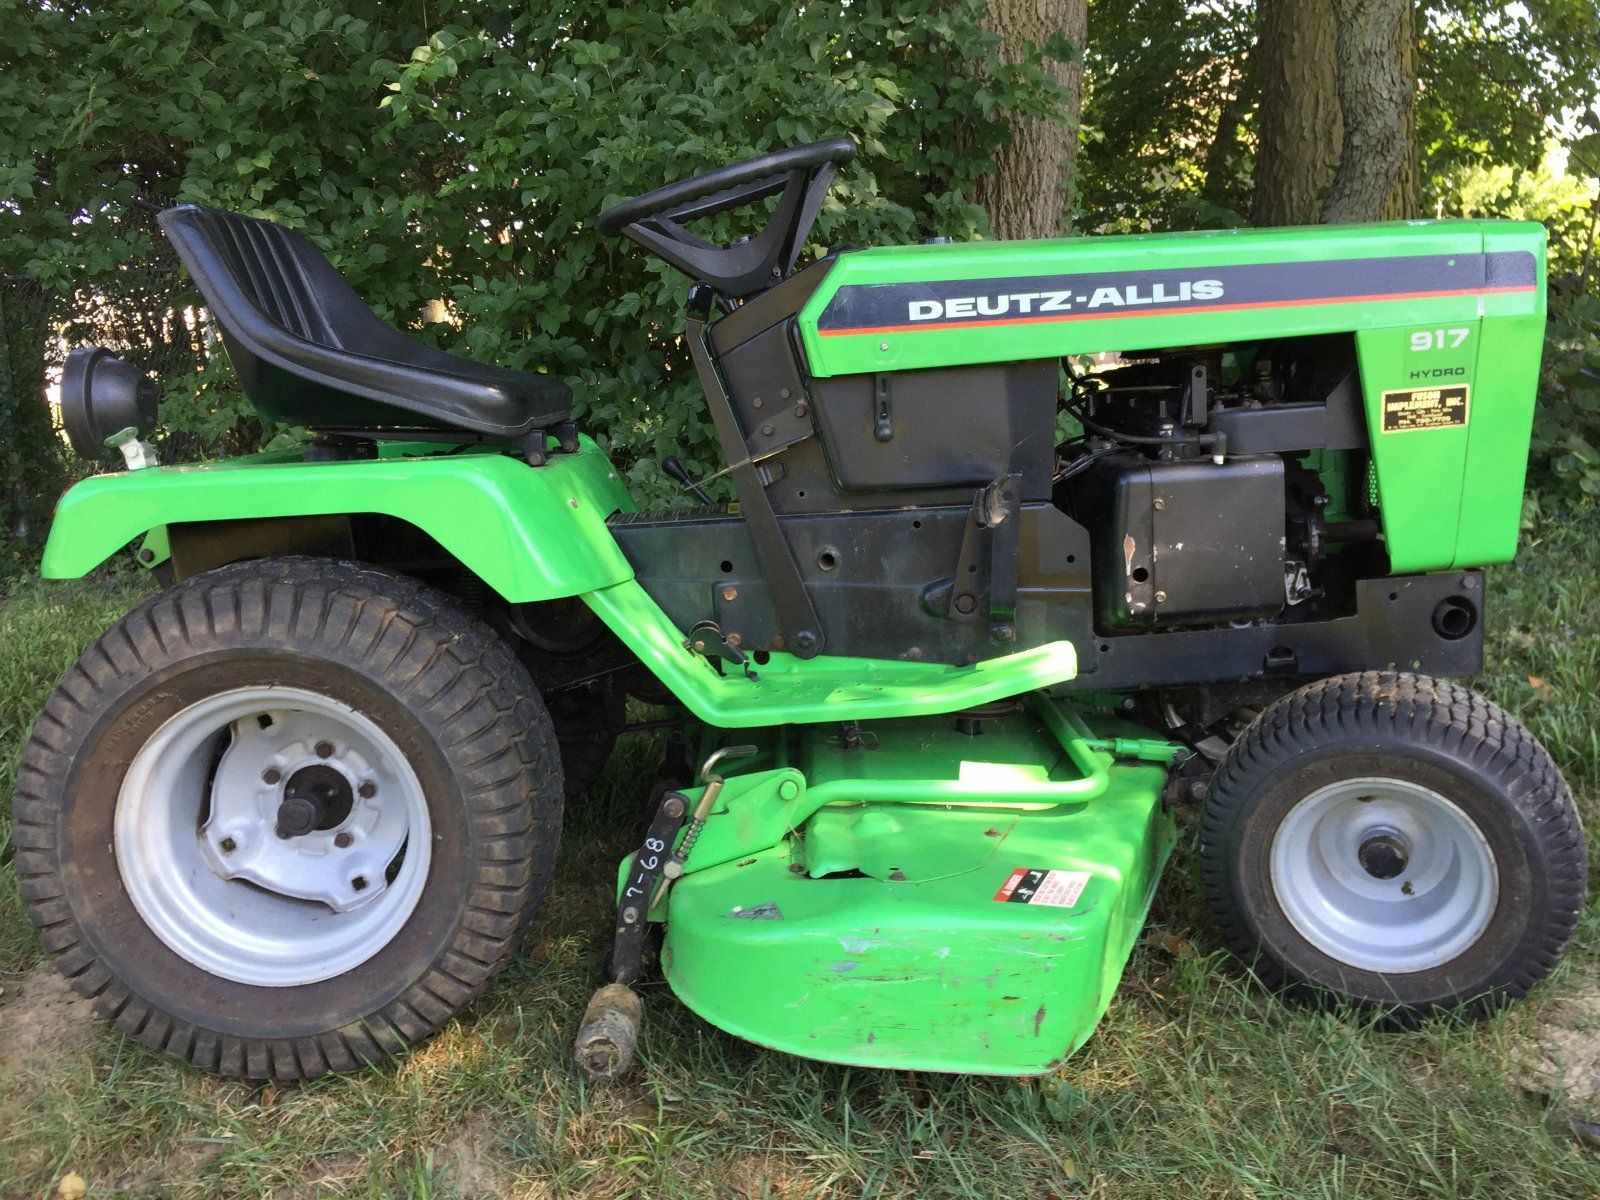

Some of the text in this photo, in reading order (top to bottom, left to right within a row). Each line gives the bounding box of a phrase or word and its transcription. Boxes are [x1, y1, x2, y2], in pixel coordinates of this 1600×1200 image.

[909, 280, 1224, 321] DEUTZ-ALLIS
[1410, 328, 1469, 351] 917
[1410, 367, 1465, 380] HYDRO
[626, 837, 665, 898] 7-68
